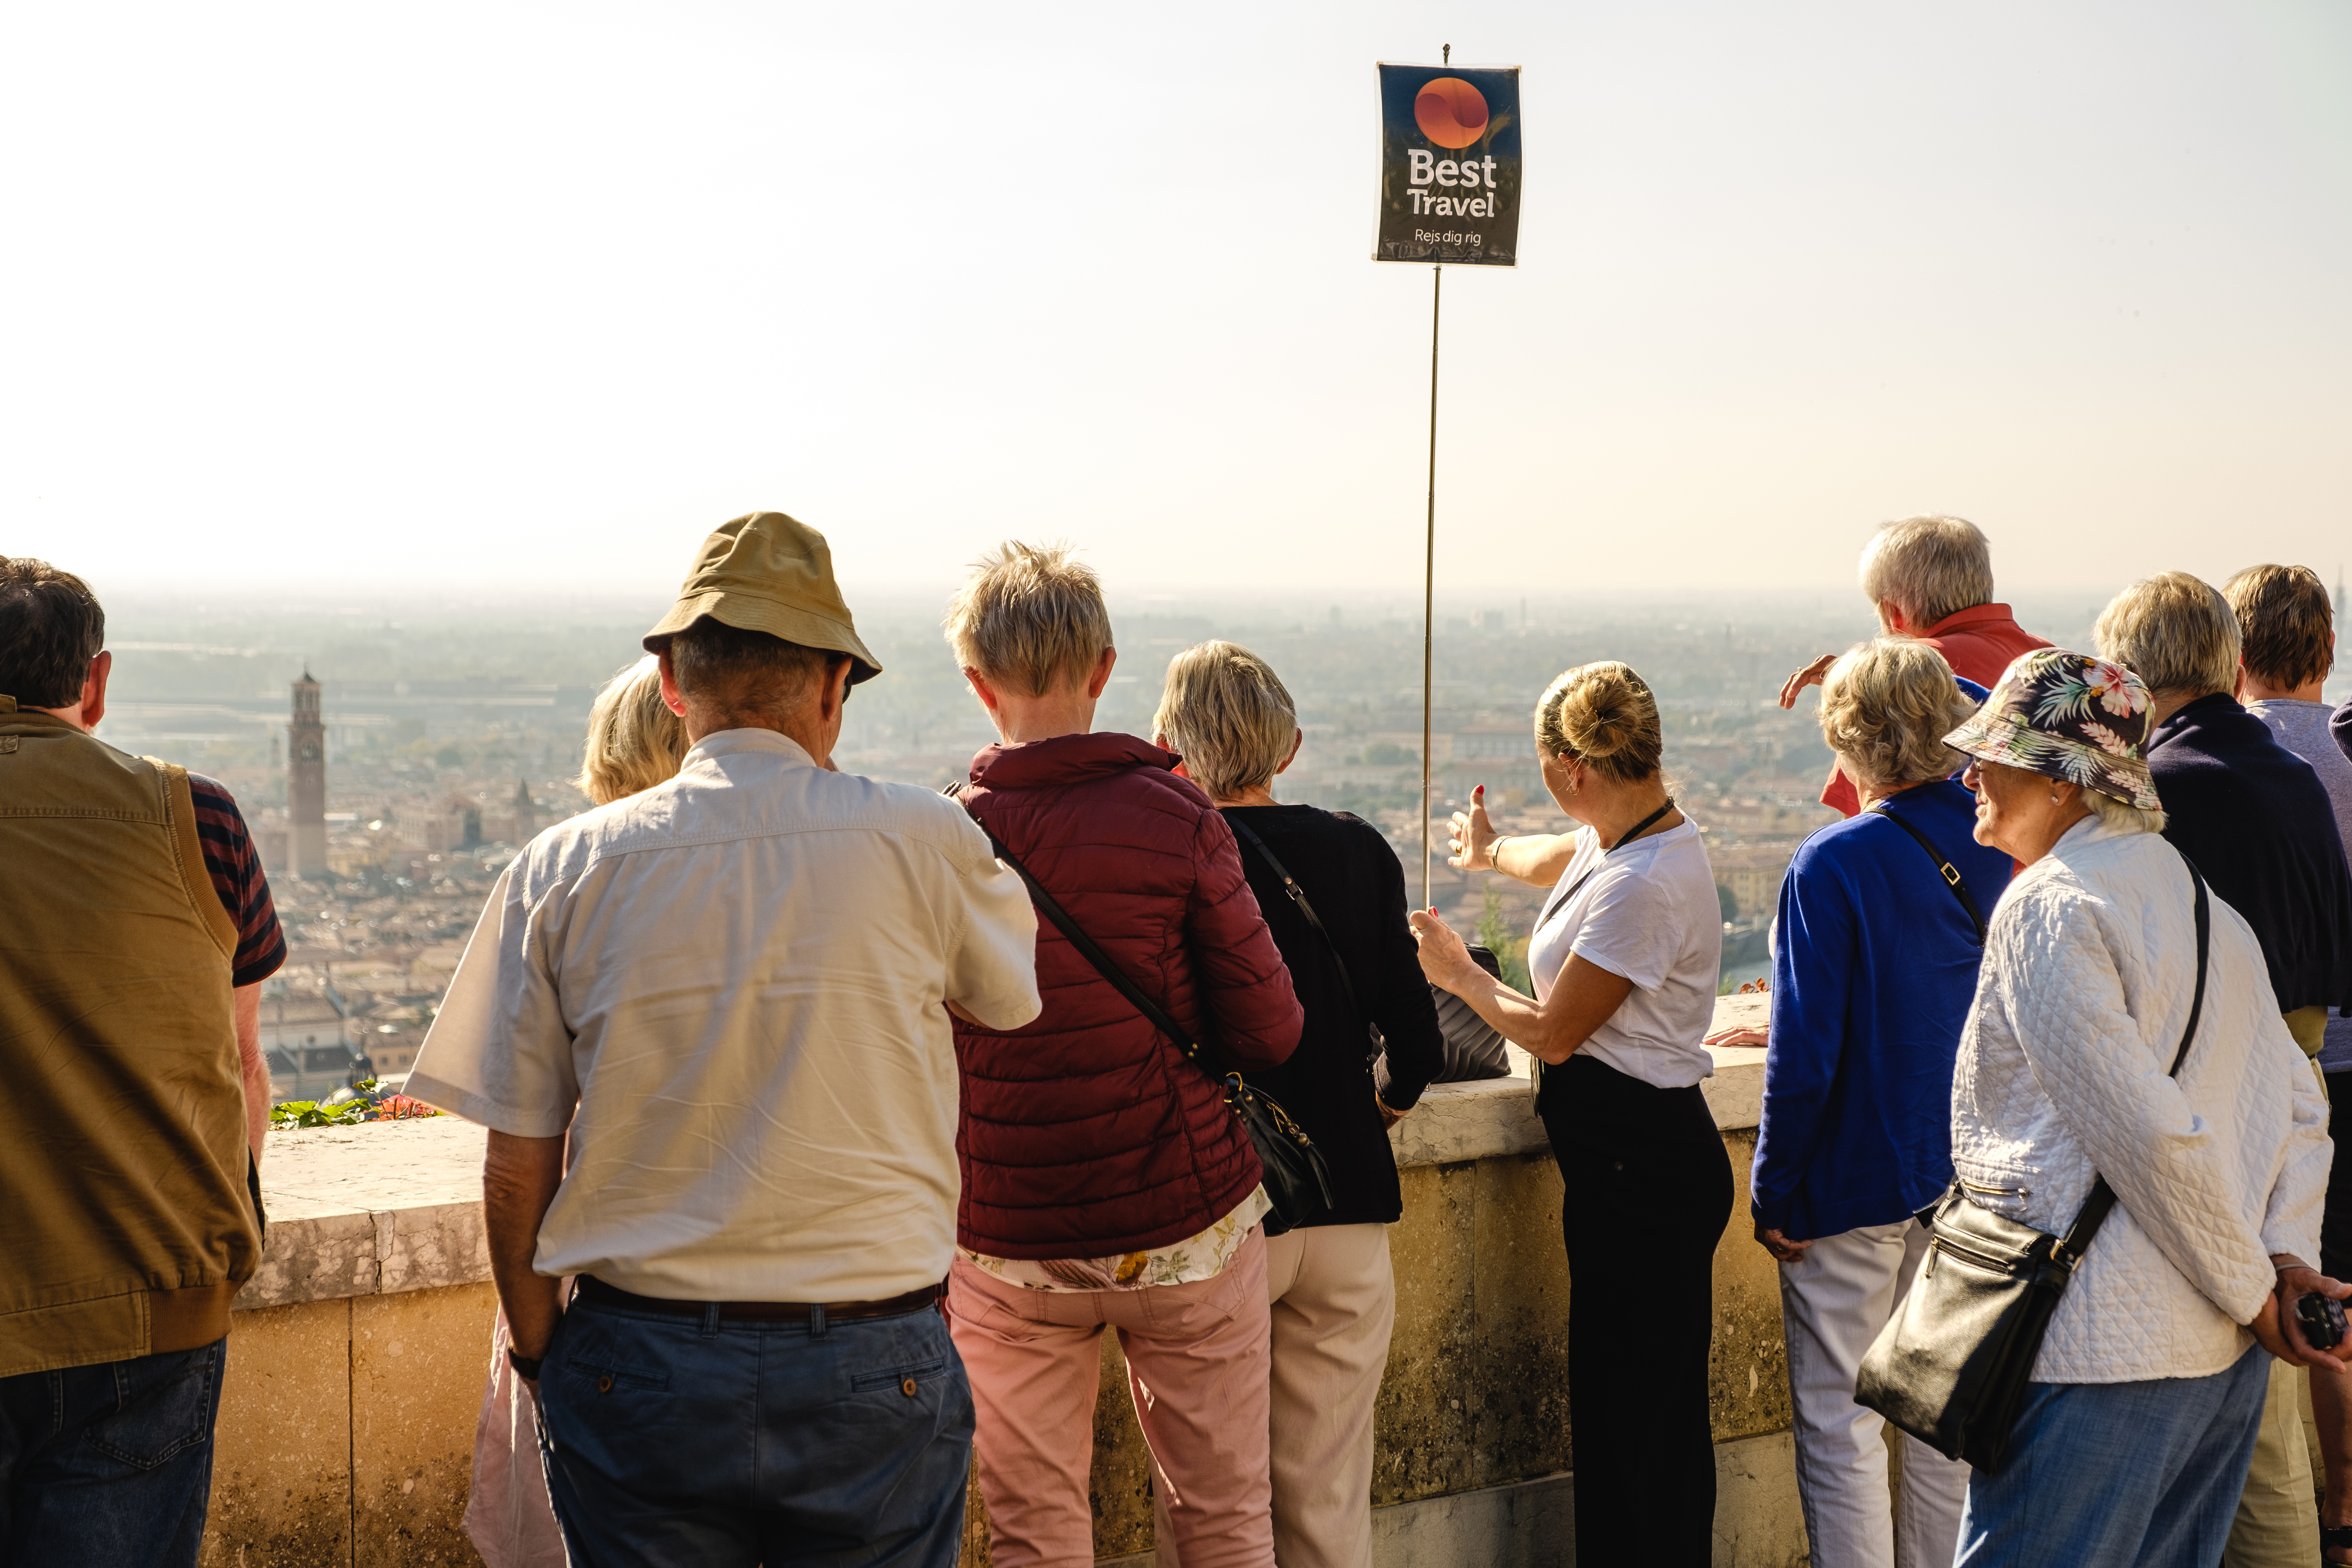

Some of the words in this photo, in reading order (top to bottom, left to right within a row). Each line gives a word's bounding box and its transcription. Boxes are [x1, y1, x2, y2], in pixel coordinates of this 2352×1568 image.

[1408, 149, 1497, 188] Best
[1406, 189, 1494, 218] Travel
[1415, 229, 1440, 245] Rejs
[1443, 230, 1462, 246] dig
[1465, 231, 1481, 247] rig
